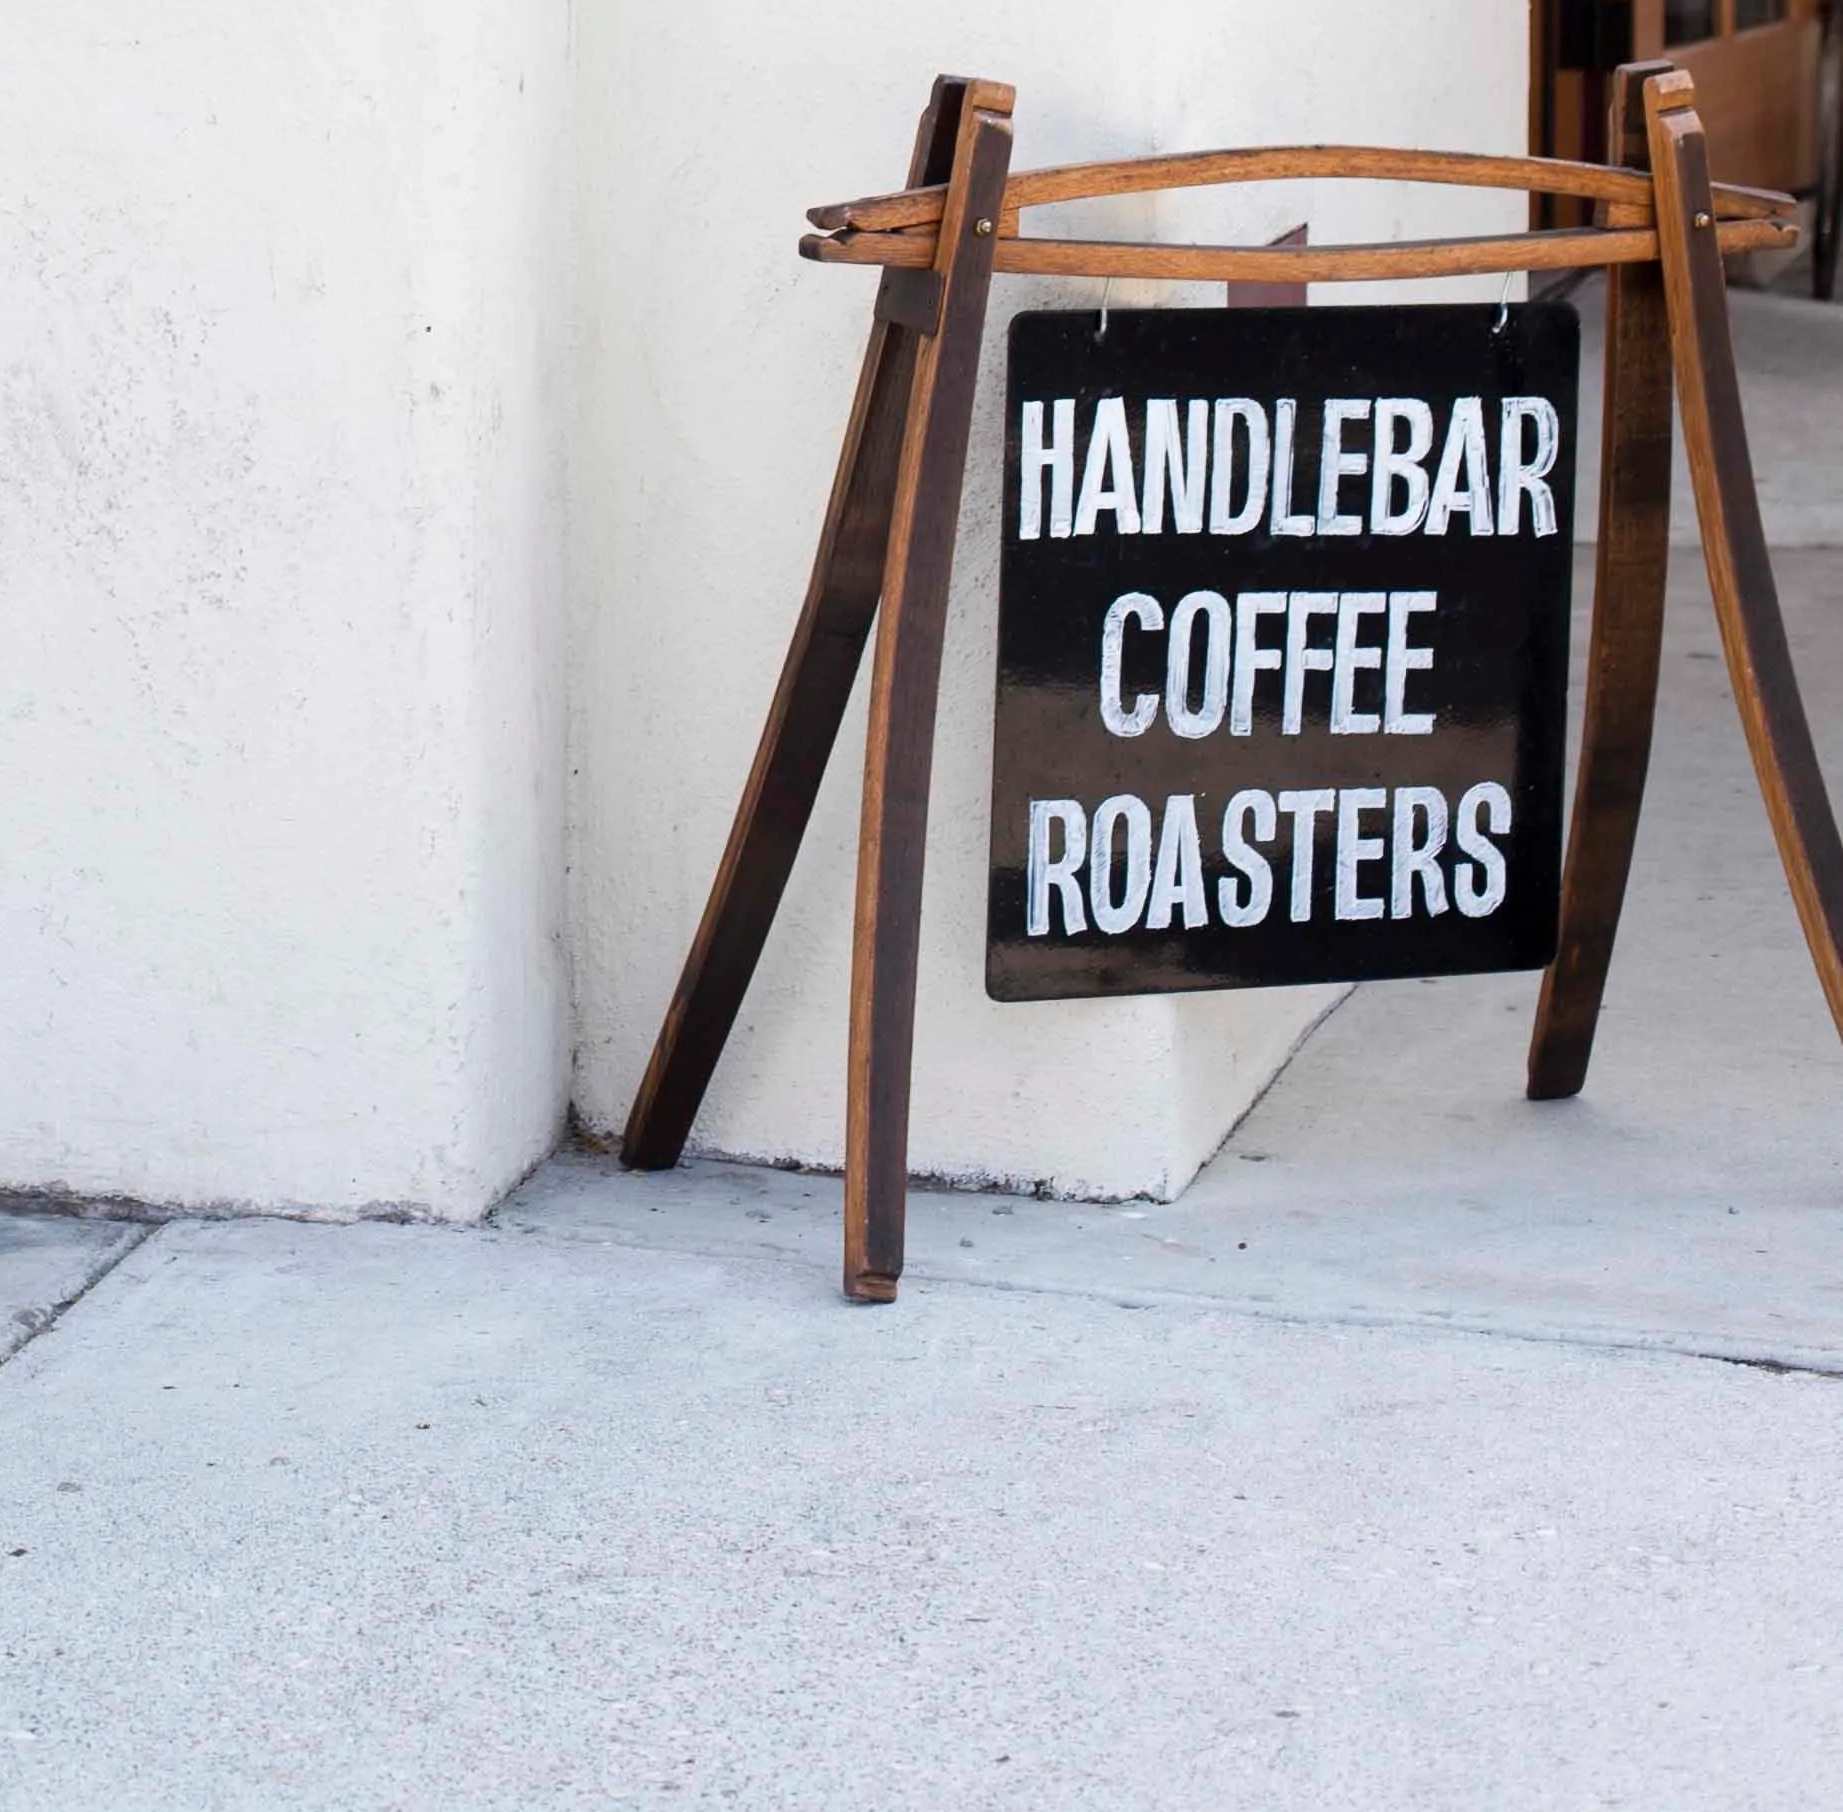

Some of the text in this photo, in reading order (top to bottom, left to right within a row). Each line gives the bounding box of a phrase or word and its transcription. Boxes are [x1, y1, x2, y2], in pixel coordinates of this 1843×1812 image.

[1018, 395, 1559, 540] HANDLEBAR
[1099, 589, 1438, 739] COFFEE
[1026, 781, 1512, 936] ROASTERS
